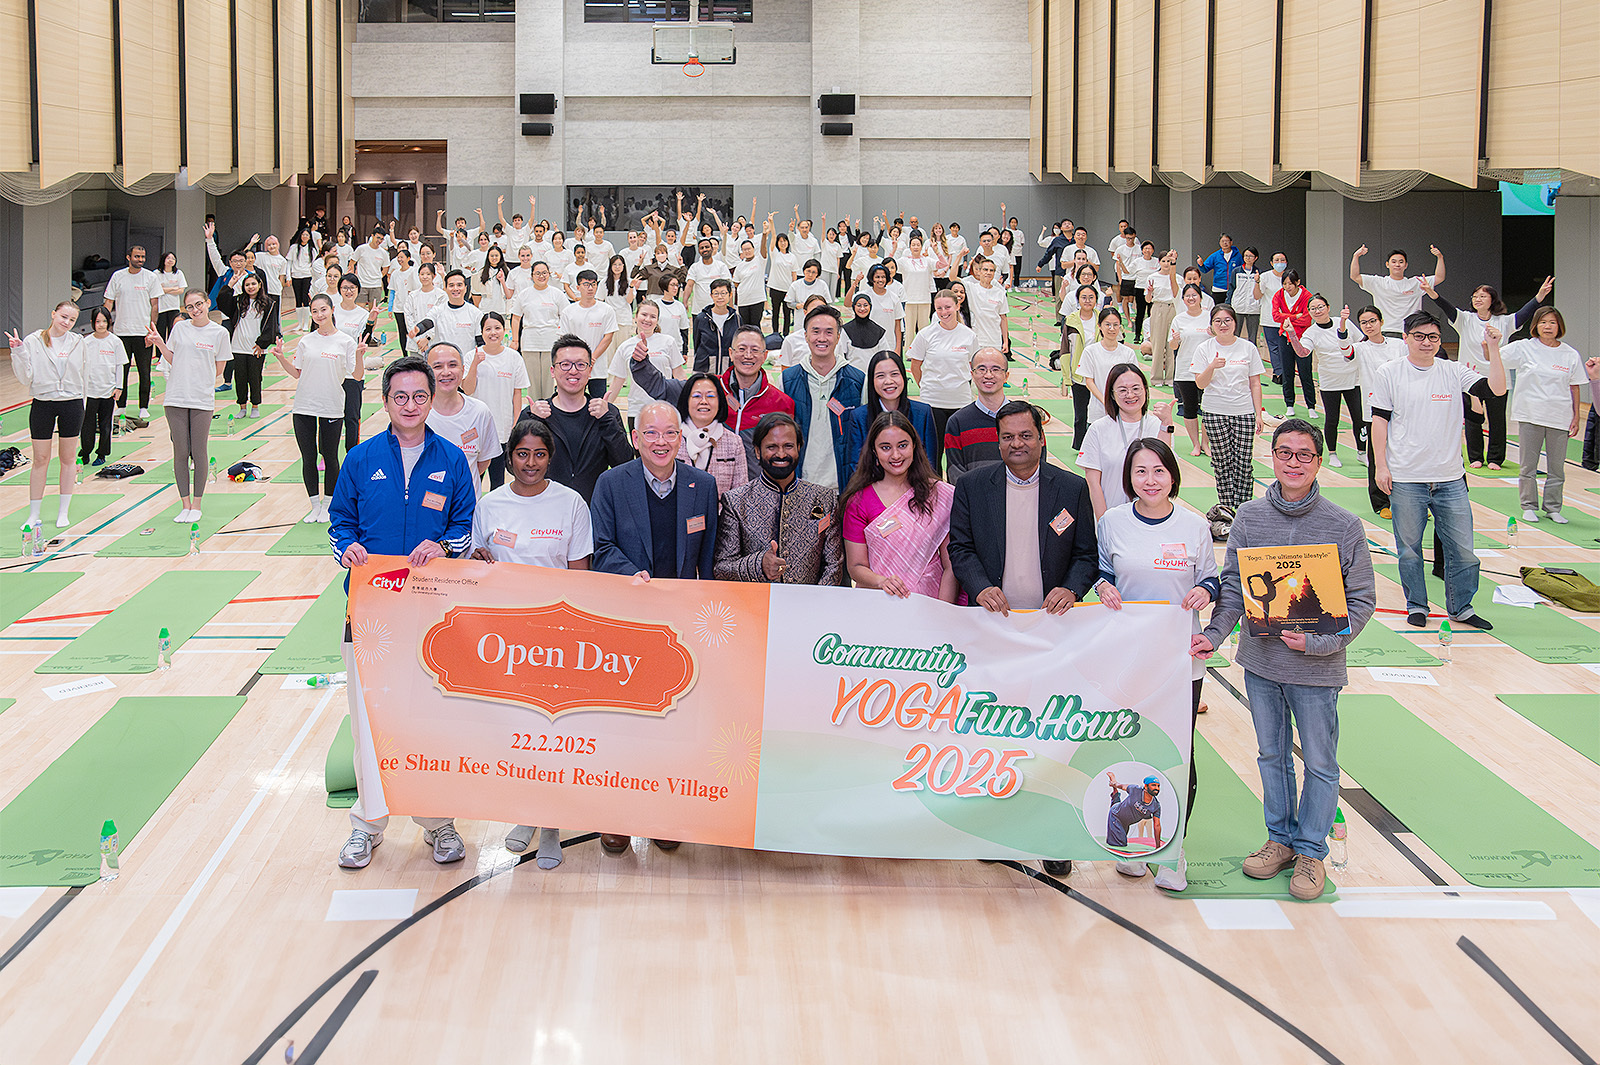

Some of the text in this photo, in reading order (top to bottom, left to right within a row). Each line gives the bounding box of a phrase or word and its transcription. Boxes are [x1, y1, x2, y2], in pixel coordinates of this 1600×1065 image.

[530, 528, 564, 537] CityUHK
[1153, 558, 1189, 568] CityUHK
[1275, 561, 1302, 569] 2025
[371, 576, 406, 590] CityU
[412, 575, 479, 586] Student Residence Office
[476, 632, 642, 686] Open Day
[812, 633, 967, 688] Community
[829, 675, 1141, 742] YOGA Fun Hour
[510, 732, 597, 756] 22.2.2025
[379, 753, 730, 803] ee Shau Kee Student Residence Village
[890, 742, 1035, 799] 2025
